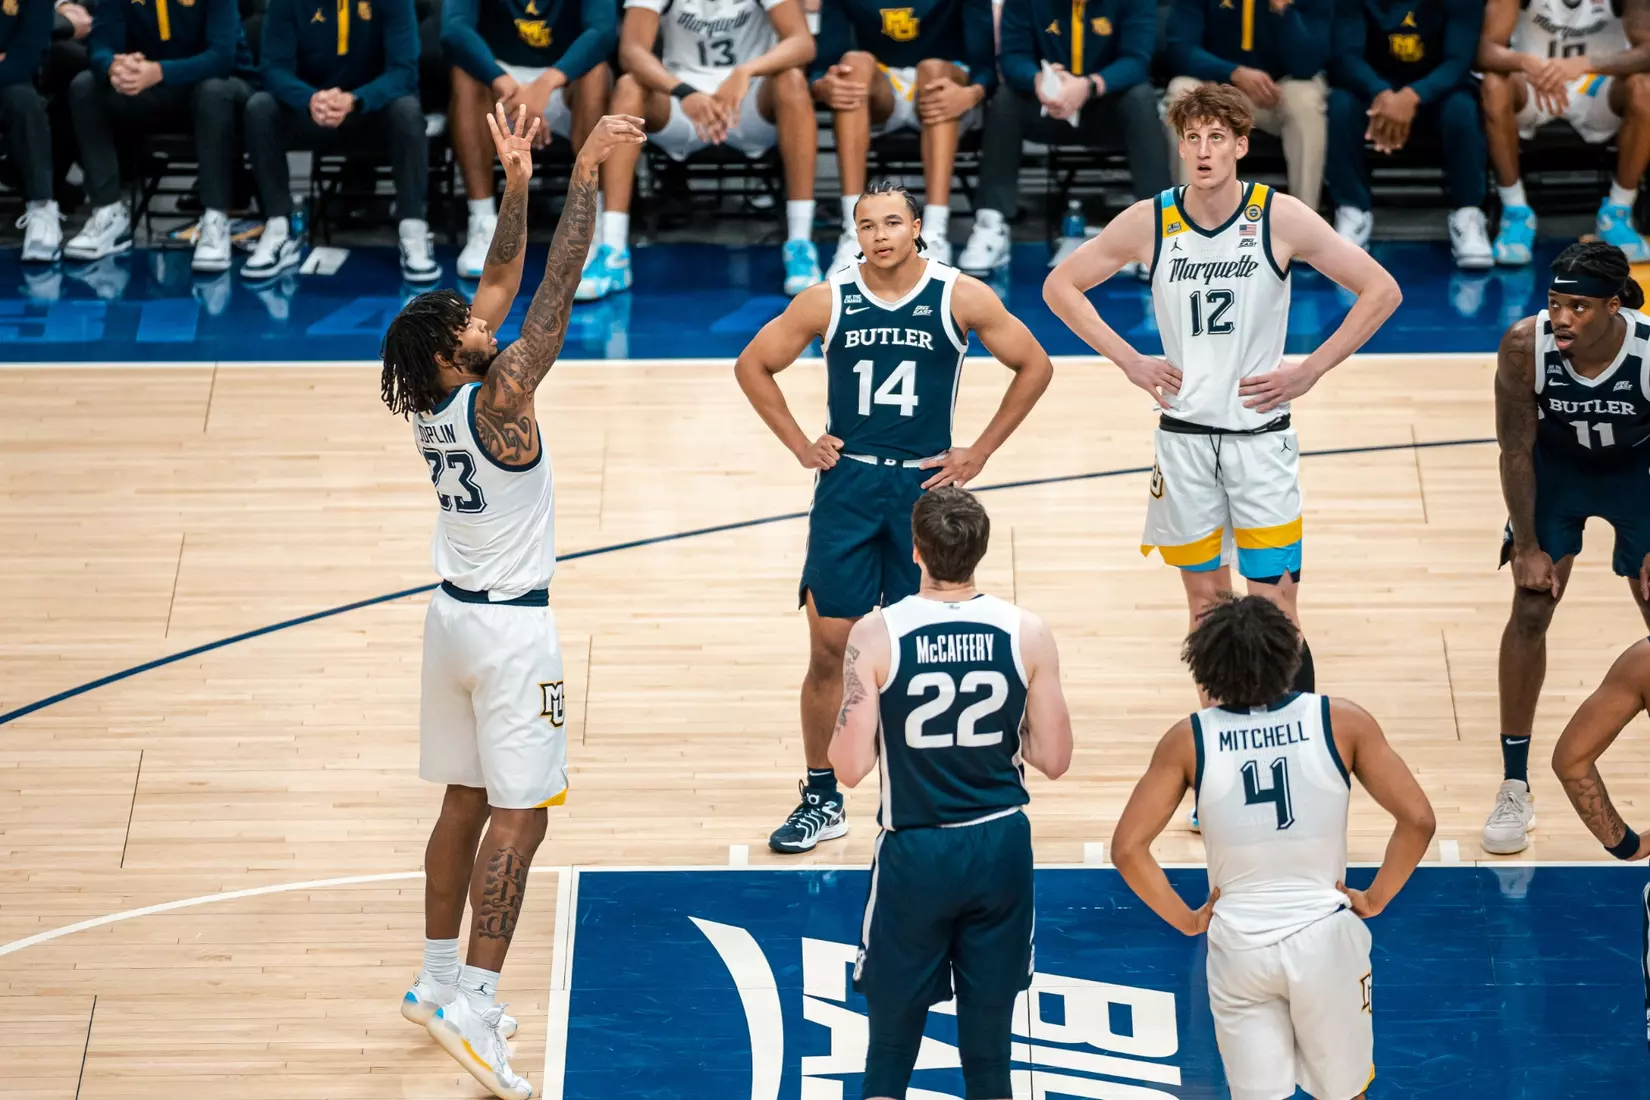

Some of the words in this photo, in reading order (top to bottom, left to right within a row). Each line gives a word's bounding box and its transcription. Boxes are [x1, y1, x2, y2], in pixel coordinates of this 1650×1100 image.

[696, 39, 736, 67] 13
[1169, 254, 1259, 286] Marquette
[1189, 288, 1236, 337] 12
[844, 327, 934, 351] BUTLER
[852, 359, 919, 417] 14
[1548, 398, 1637, 415] BUTLER
[1568, 420, 1616, 450] 11
[422, 447, 488, 514] 23
[915, 633, 994, 664] McCAFFERY
[904, 670, 1009, 749] 22
[1219, 720, 1310, 752] MITCHELL
[1240, 756, 1295, 831] 4
